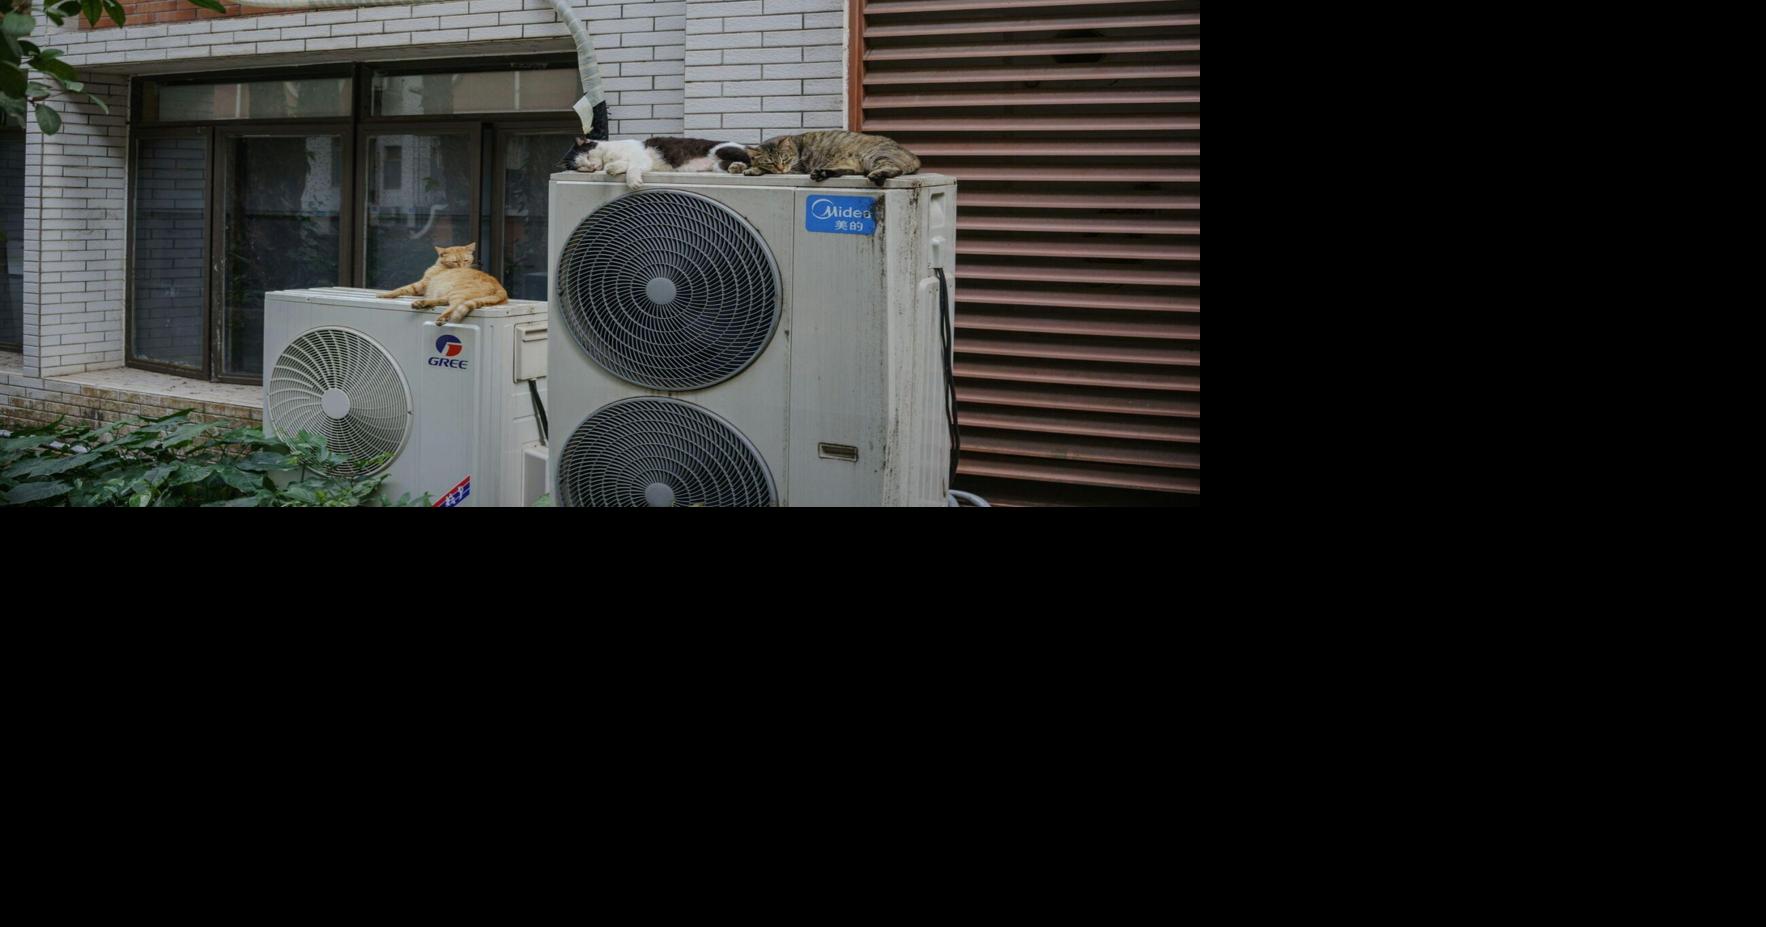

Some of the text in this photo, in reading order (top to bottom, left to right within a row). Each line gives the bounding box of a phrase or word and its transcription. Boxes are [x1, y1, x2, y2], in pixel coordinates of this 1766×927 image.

[818, 204, 872, 219] Midea
[834, 220, 864, 231] 美的
[428, 356, 469, 370] GREE
